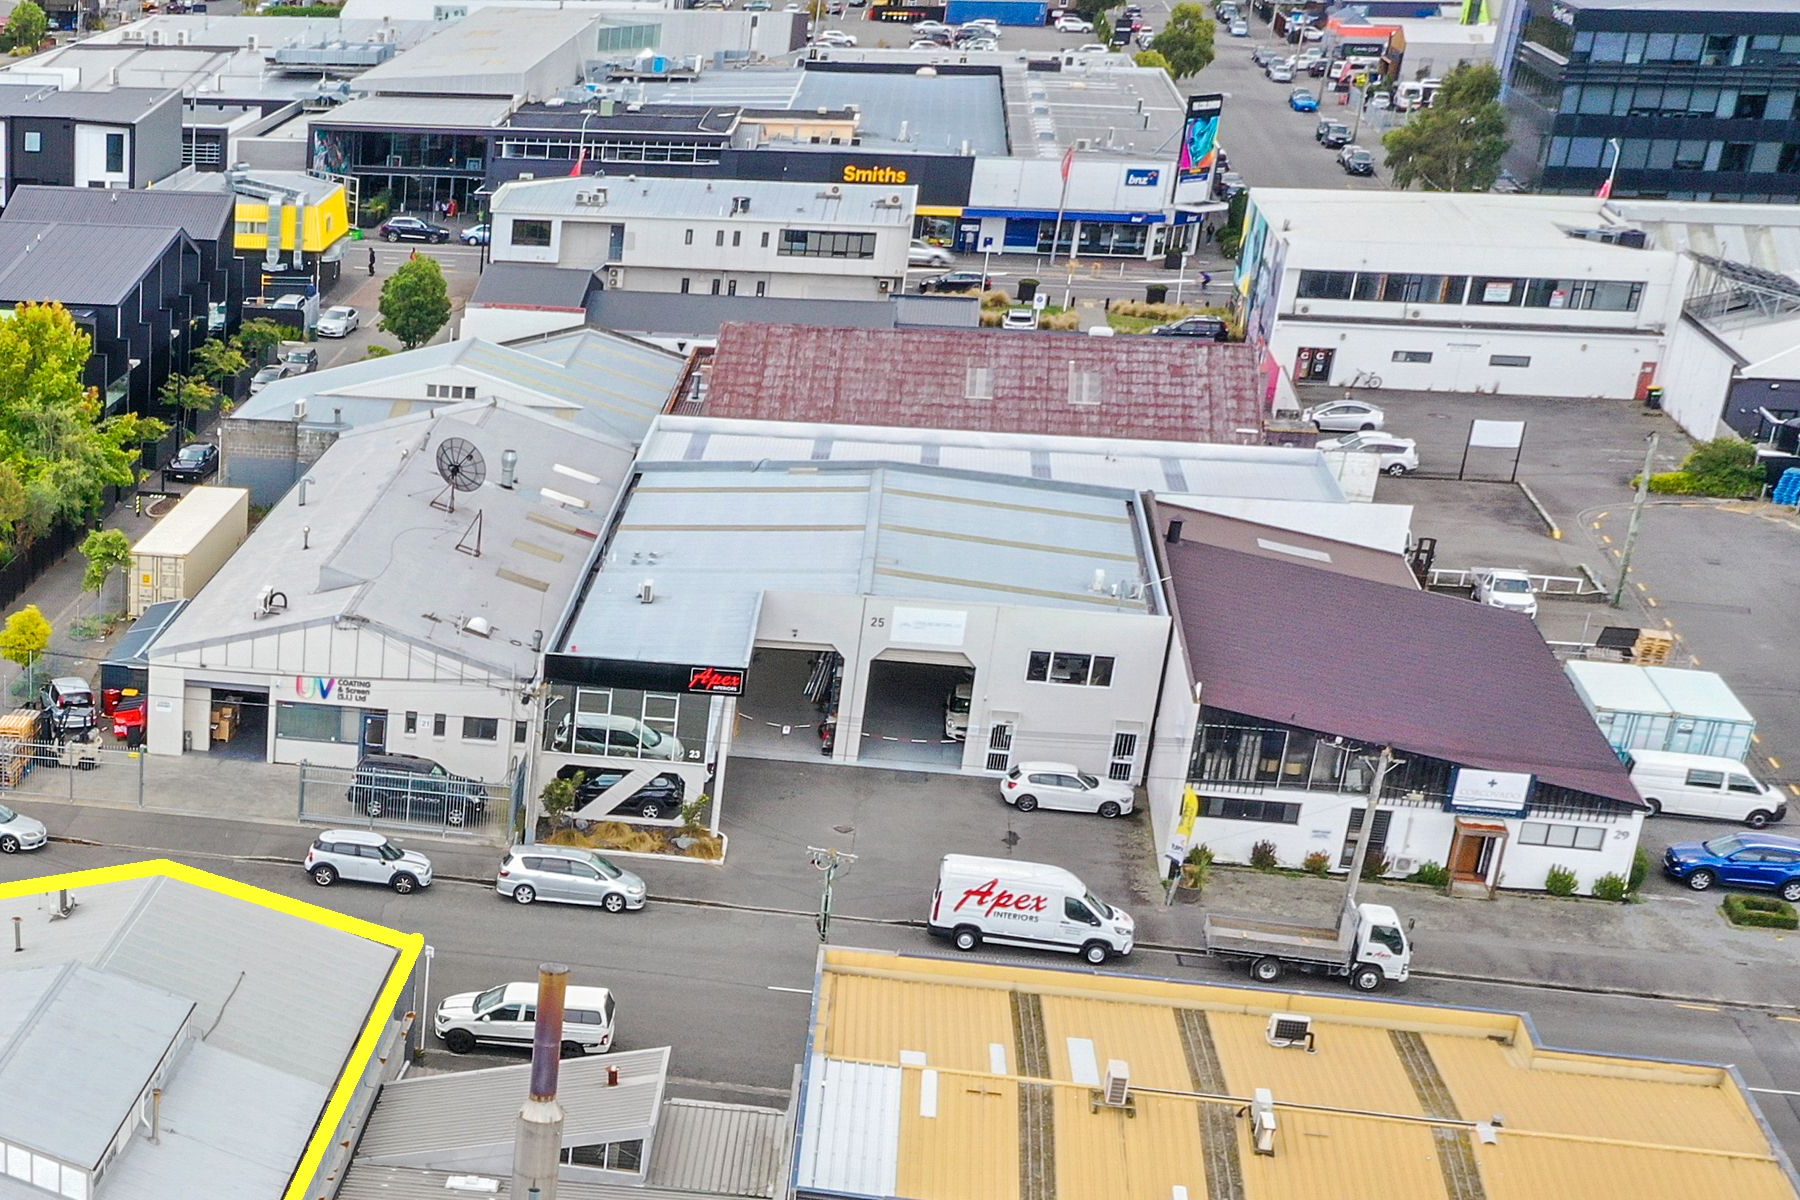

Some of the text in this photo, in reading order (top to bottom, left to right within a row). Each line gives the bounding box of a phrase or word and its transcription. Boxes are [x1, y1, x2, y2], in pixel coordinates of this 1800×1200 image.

[843, 165, 906, 183] Smiths
[1128, 174, 1149, 185] bnz
[871, 617, 885, 627] 25
[338, 680, 371, 688] COATING
[688, 667, 740, 690] Apex
[296, 675, 336, 699] UV
[345, 687, 370, 695] Screen
[689, 750, 700, 758] 23
[1613, 830, 1630, 840] 29
[954, 878, 1048, 918] Apex
[993, 911, 1039, 923] INTERIORS
